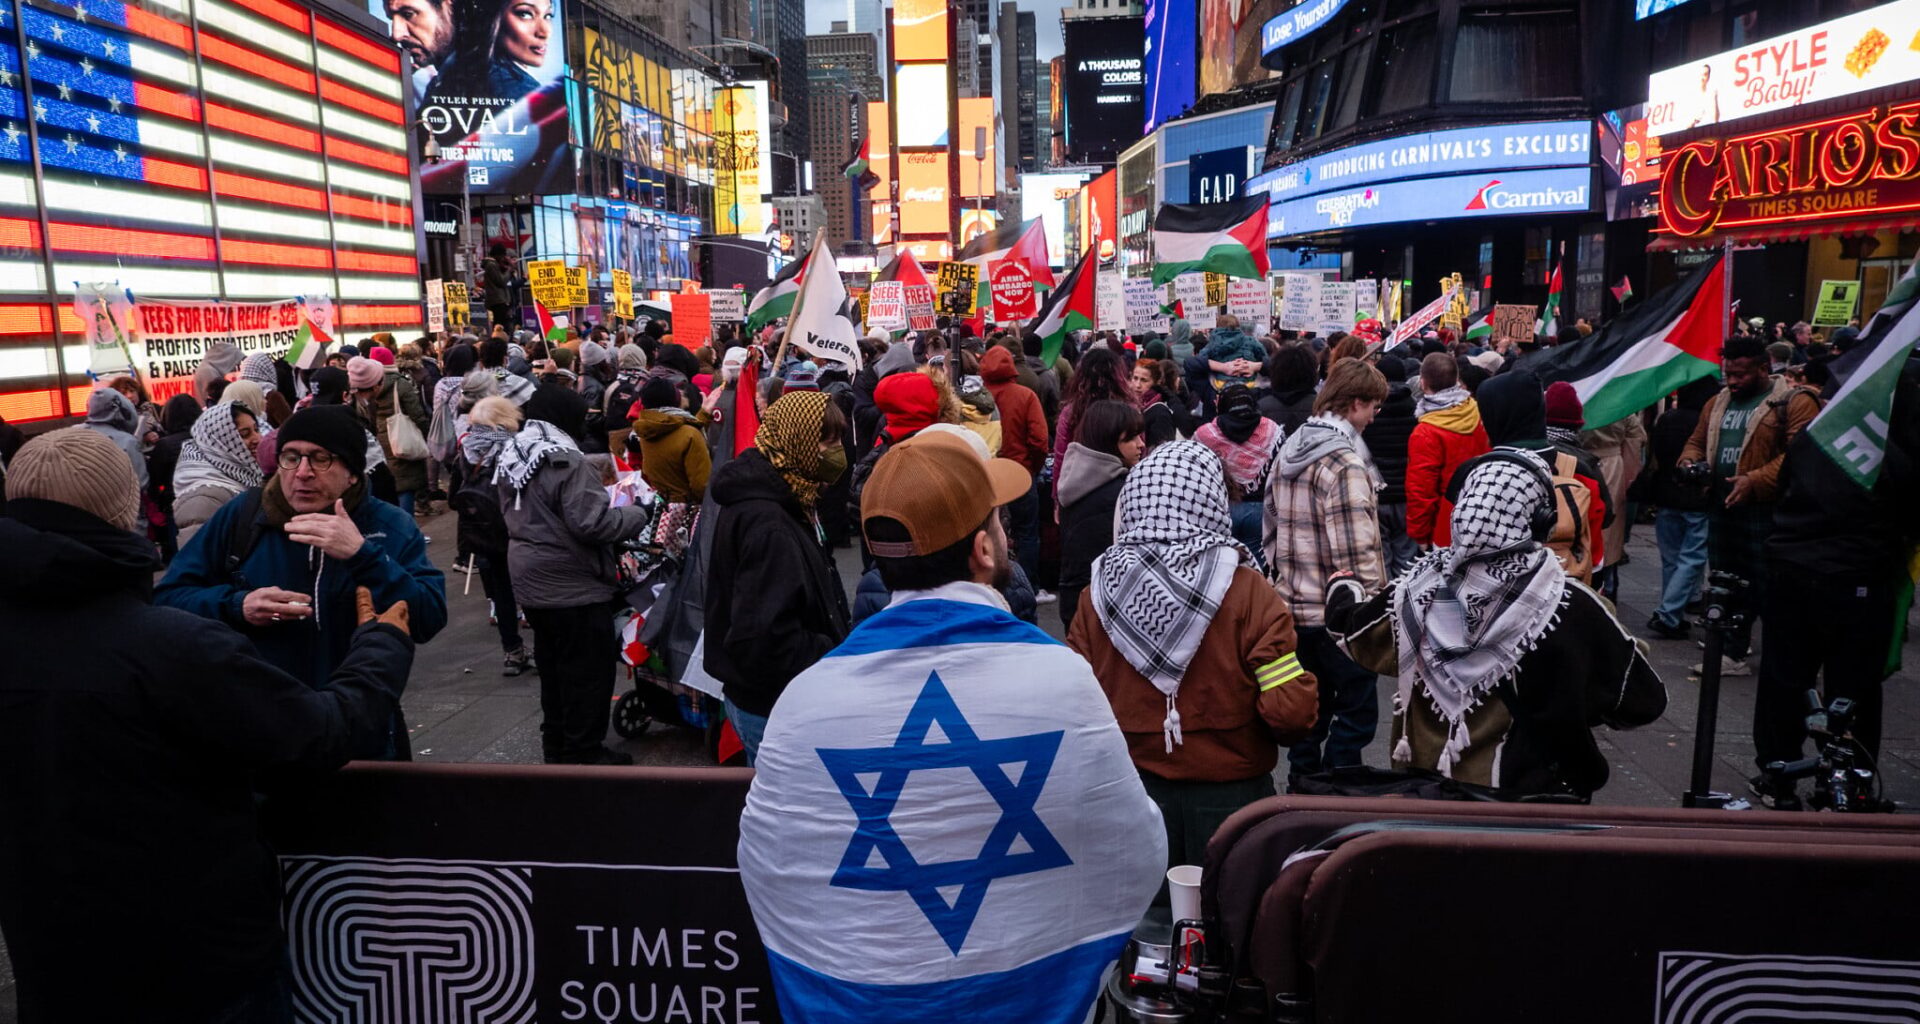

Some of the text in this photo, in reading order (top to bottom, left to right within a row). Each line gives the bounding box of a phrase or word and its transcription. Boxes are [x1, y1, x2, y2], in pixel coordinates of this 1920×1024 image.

[1269, 22, 1292, 45] Lose
[1079, 59, 1141, 71] A THOUSAND
[1734, 31, 1828, 87] STYLE
[1103, 72, 1141, 82] COLORS
[1743, 71, 1816, 108] Baby!
[431, 95, 515, 106] TYLER PERRY'S
[421, 105, 528, 136] OVAL
[440, 147, 465, 160] TUES
[465, 148, 484, 161] JAN
[484, 148, 490, 161] 7
[1320, 133, 1589, 180] INTRODUCING CARNIVAL'S EXCLUSI
[1661, 106, 1920, 236] CARLO'S
[1200, 173, 1235, 204] GAP
[1316, 189, 1379, 214] CELEBRATION
[1491, 186, 1585, 209] Carnival
[1748, 188, 1878, 218] TIMES SQUARE
[538, 268, 556, 278] END
[565, 269, 580, 277] END
[942, 262, 977, 280] FREE
[1000, 275, 1024, 283] ARMS
[533, 278, 564, 287] WEAPONS
[567, 278, 580, 286] ALL
[992, 281, 1033, 291] EMBARGO
[576, 288, 586, 296] AID
[872, 287, 900, 299] SIEGE
[904, 287, 930, 304] FREE
[1004, 289, 1024, 297] NOW
[139, 305, 174, 334] TEES
[176, 304, 201, 333] FOR
[203, 303, 234, 332] GAZA
[237, 303, 273, 330] RELIEF
[279, 302, 299, 327] $25
[870, 304, 898, 317] NOW!
[909, 316, 935, 329] NOW!
[146, 336, 200, 357] PROFITS
[259, 333, 271, 348] TO
[149, 360, 202, 378] & PALES
[576, 925, 740, 971] TIMES
[561, 980, 760, 1024] SQUARE
